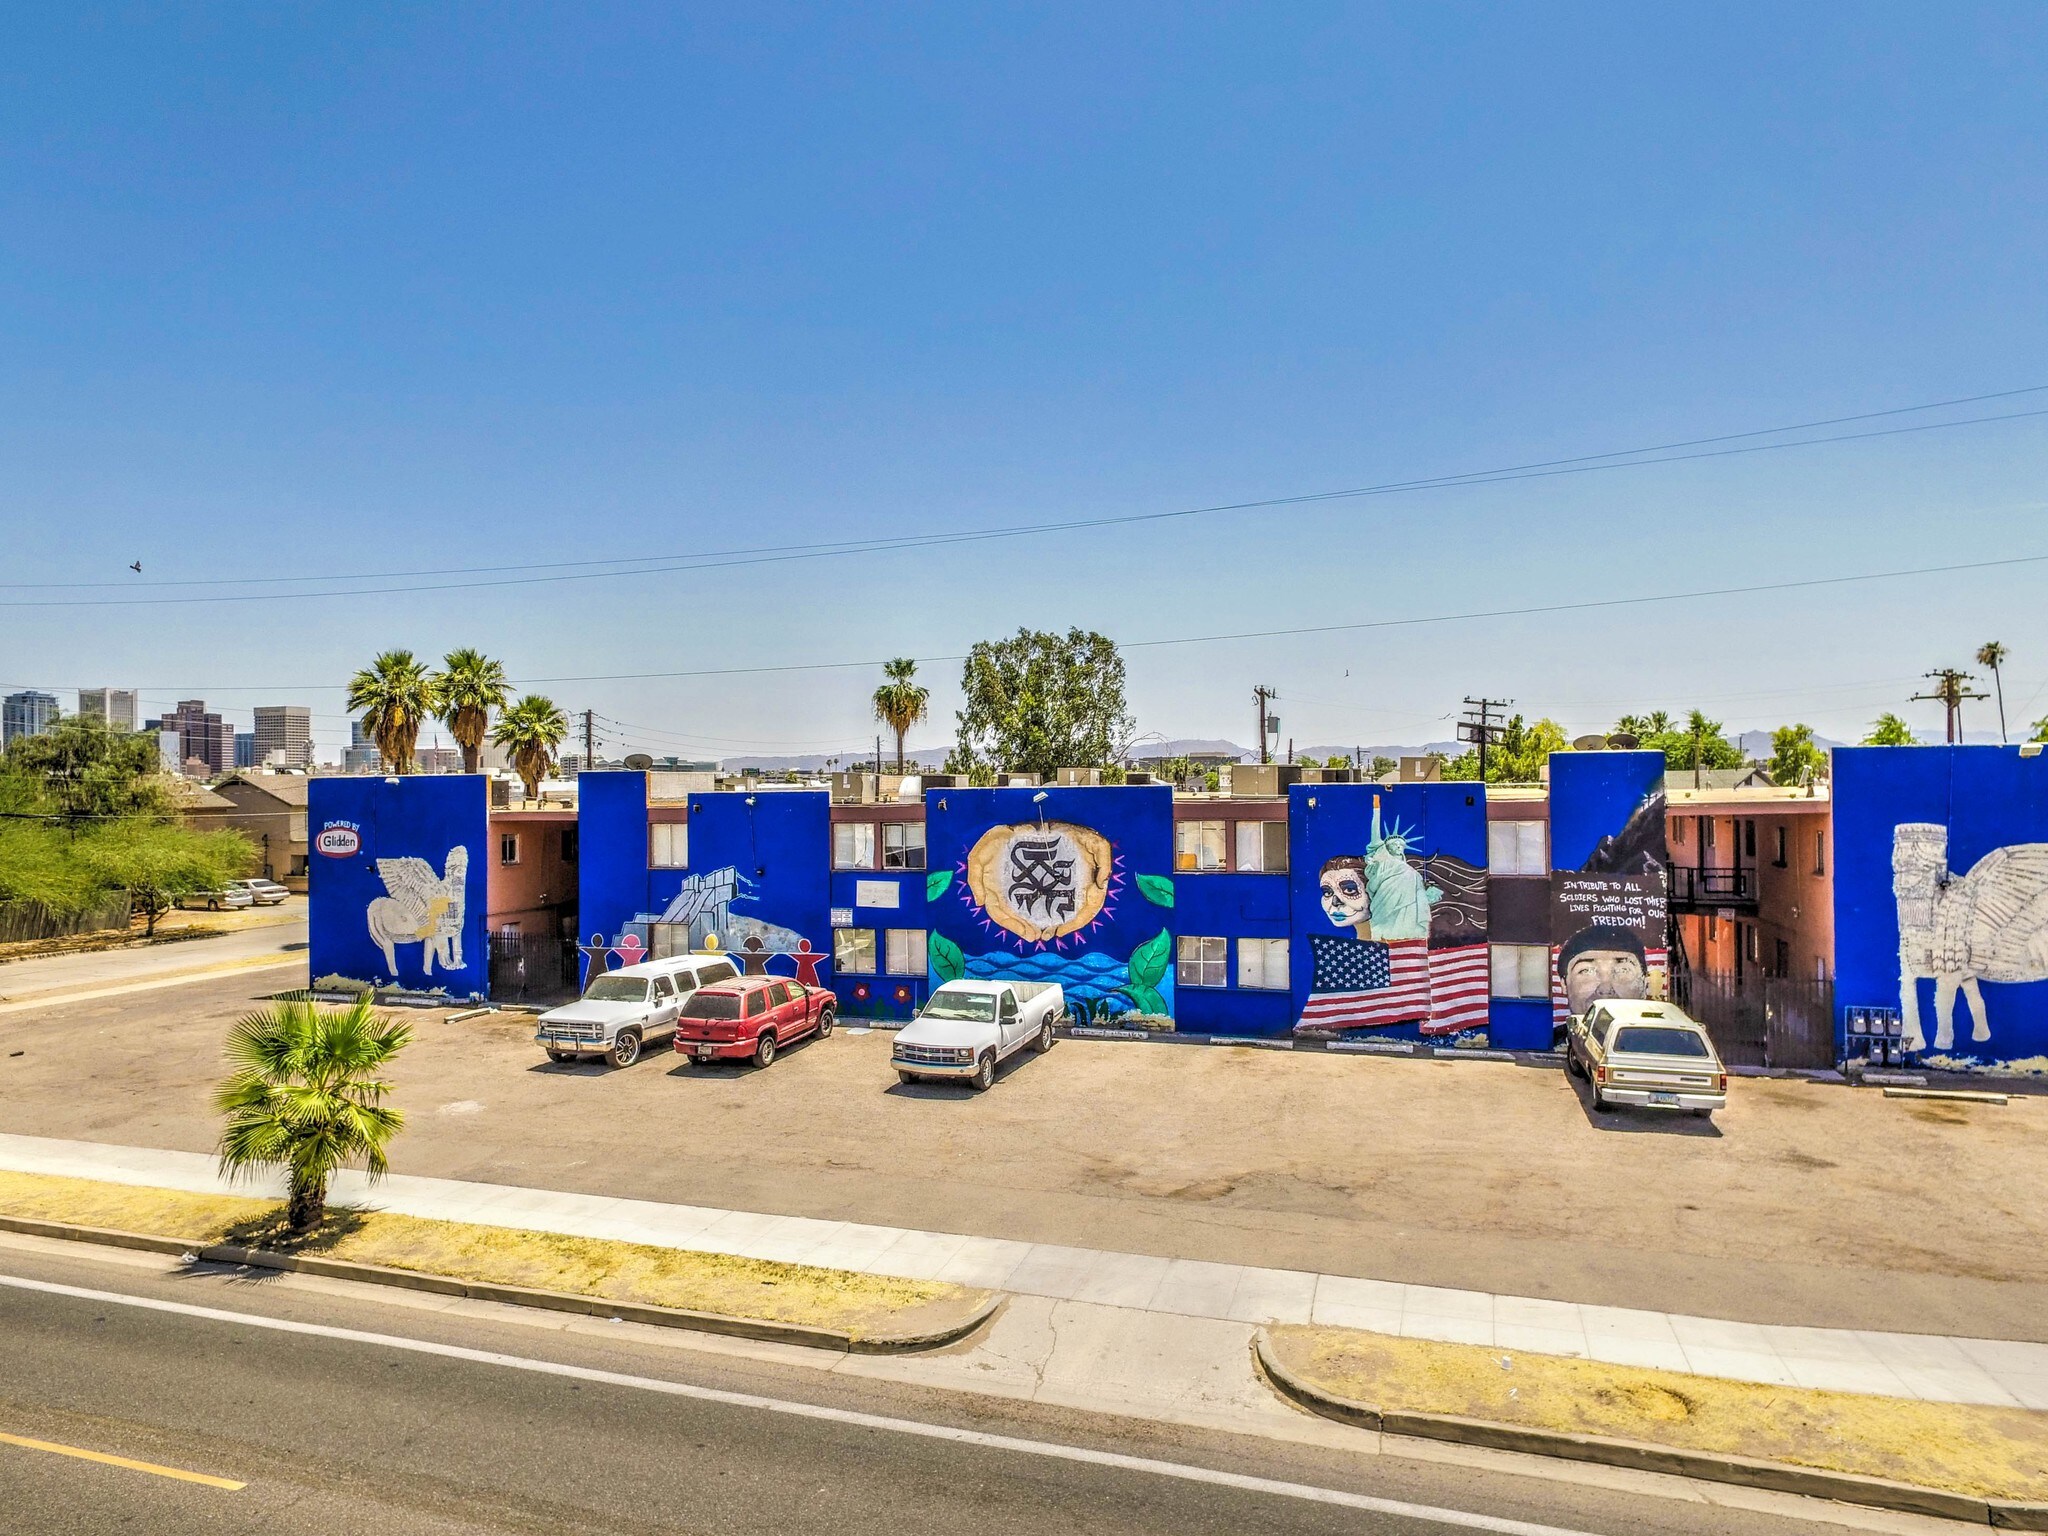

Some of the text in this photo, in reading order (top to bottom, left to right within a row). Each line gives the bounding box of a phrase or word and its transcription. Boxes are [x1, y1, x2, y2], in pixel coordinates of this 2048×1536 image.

[324, 820, 360, 832] POWERED BY
[323, 835, 356, 847] Glidden
[1563, 880, 1642, 892] IN TRIBUTE TO ALL
[1559, 893, 1598, 903] SOLDIERS
[1601, 895, 1620, 903] WHO
[1624, 896, 1644, 905] LOST
[1569, 904, 1667, 919] LIVES FIGHTING FOR OUR
[1591, 915, 1646, 930] FREEDOM!
